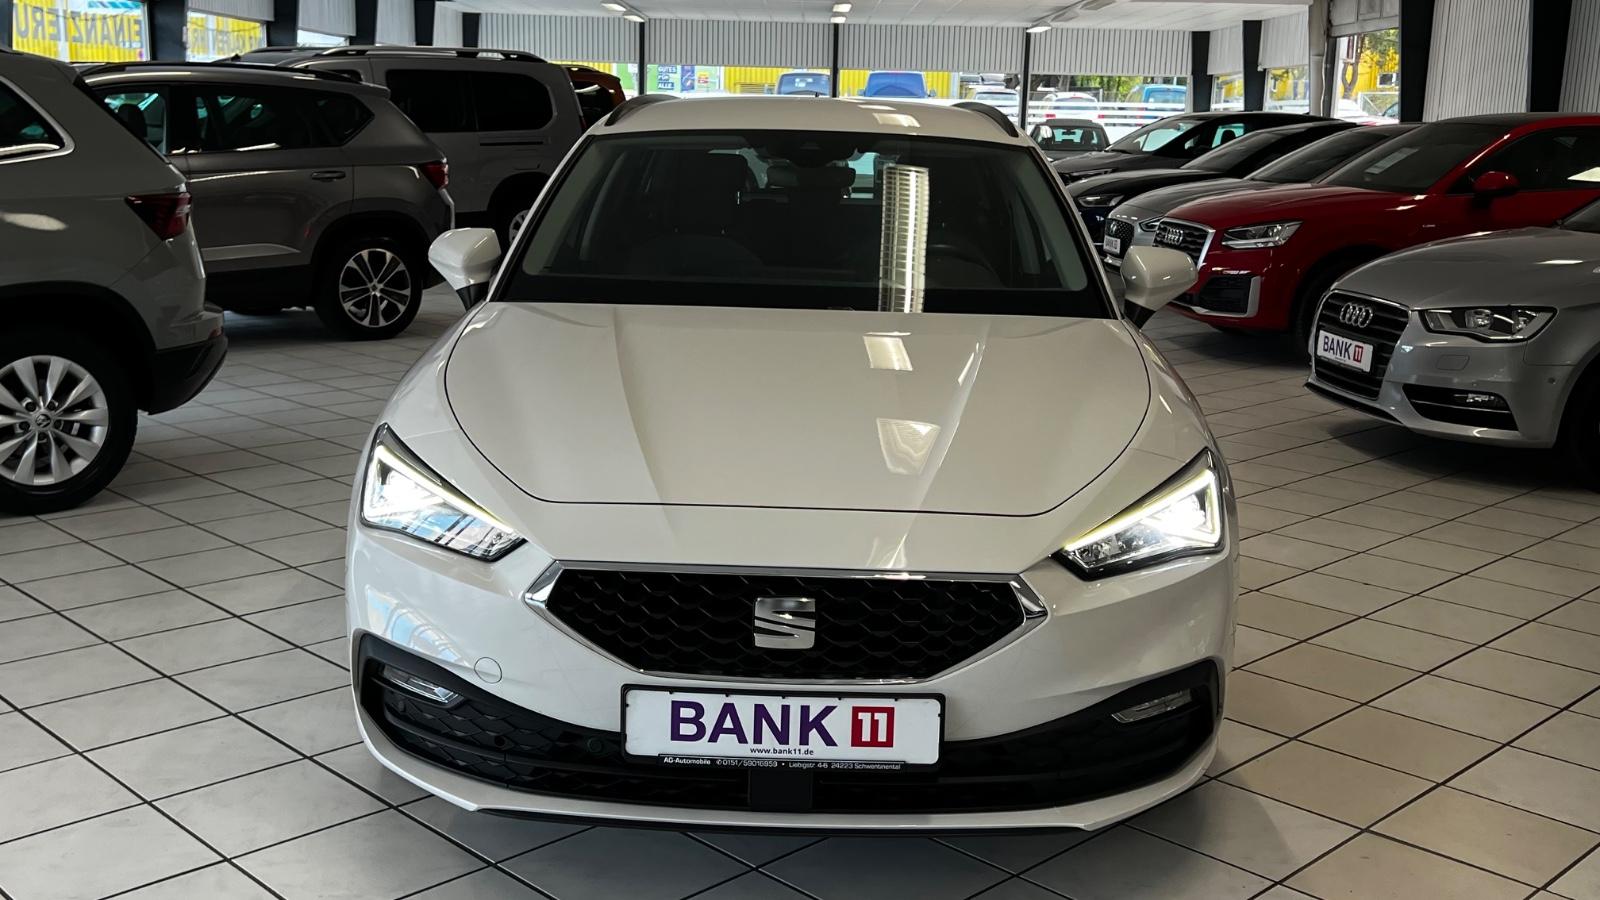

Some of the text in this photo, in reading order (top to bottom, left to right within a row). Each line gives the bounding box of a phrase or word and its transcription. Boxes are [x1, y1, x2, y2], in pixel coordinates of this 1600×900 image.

[1321, 334, 1346, 355] BANK
[671, 700, 890, 747] BANK 11
[749, 747, 814, 756] www.bank11.de
